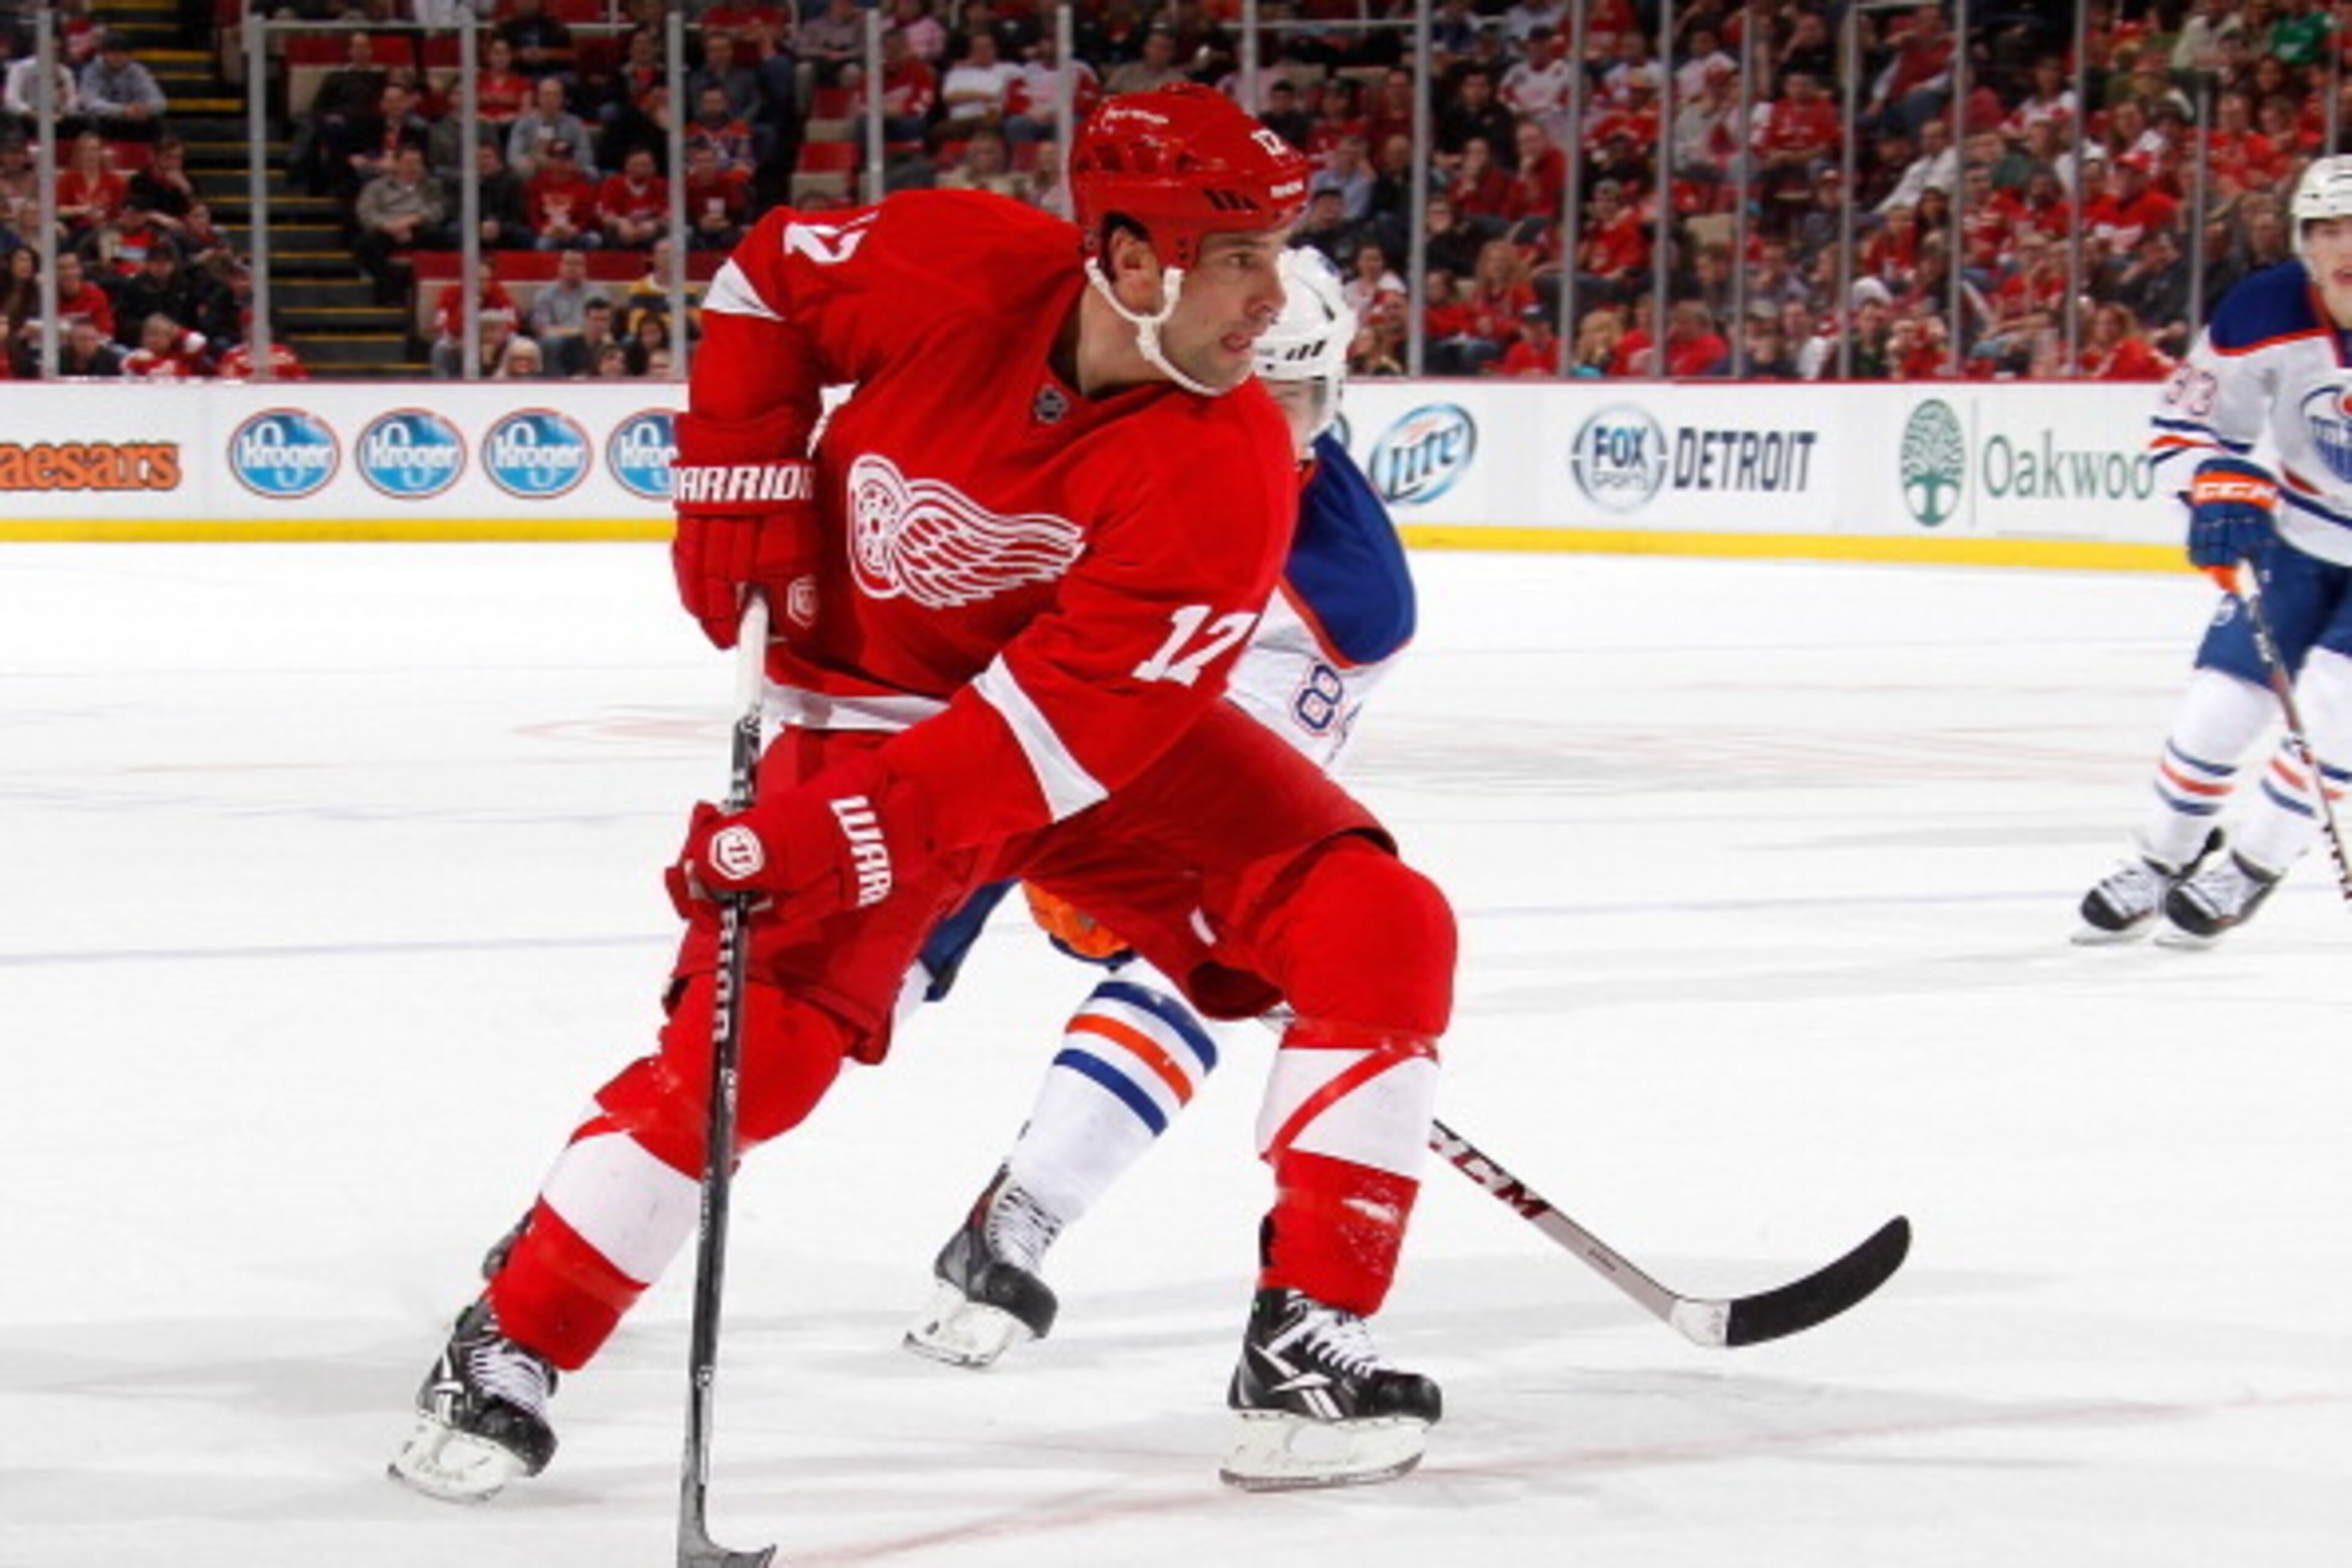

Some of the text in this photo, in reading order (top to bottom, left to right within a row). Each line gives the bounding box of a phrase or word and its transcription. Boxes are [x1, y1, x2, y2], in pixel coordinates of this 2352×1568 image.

[783, 209, 880, 265] 2
[0, 440, 182, 491] aesars
[241, 420, 331, 487] Kroger
[369, 420, 458, 488] Kroger
[495, 420, 583, 488] Kroger
[1593, 426, 1649, 469] FOX
[1674, 428, 1818, 492] DETROIT
[1983, 429, 2154, 500] Oakwoo
[673, 464, 816, 502] ARRIOR
